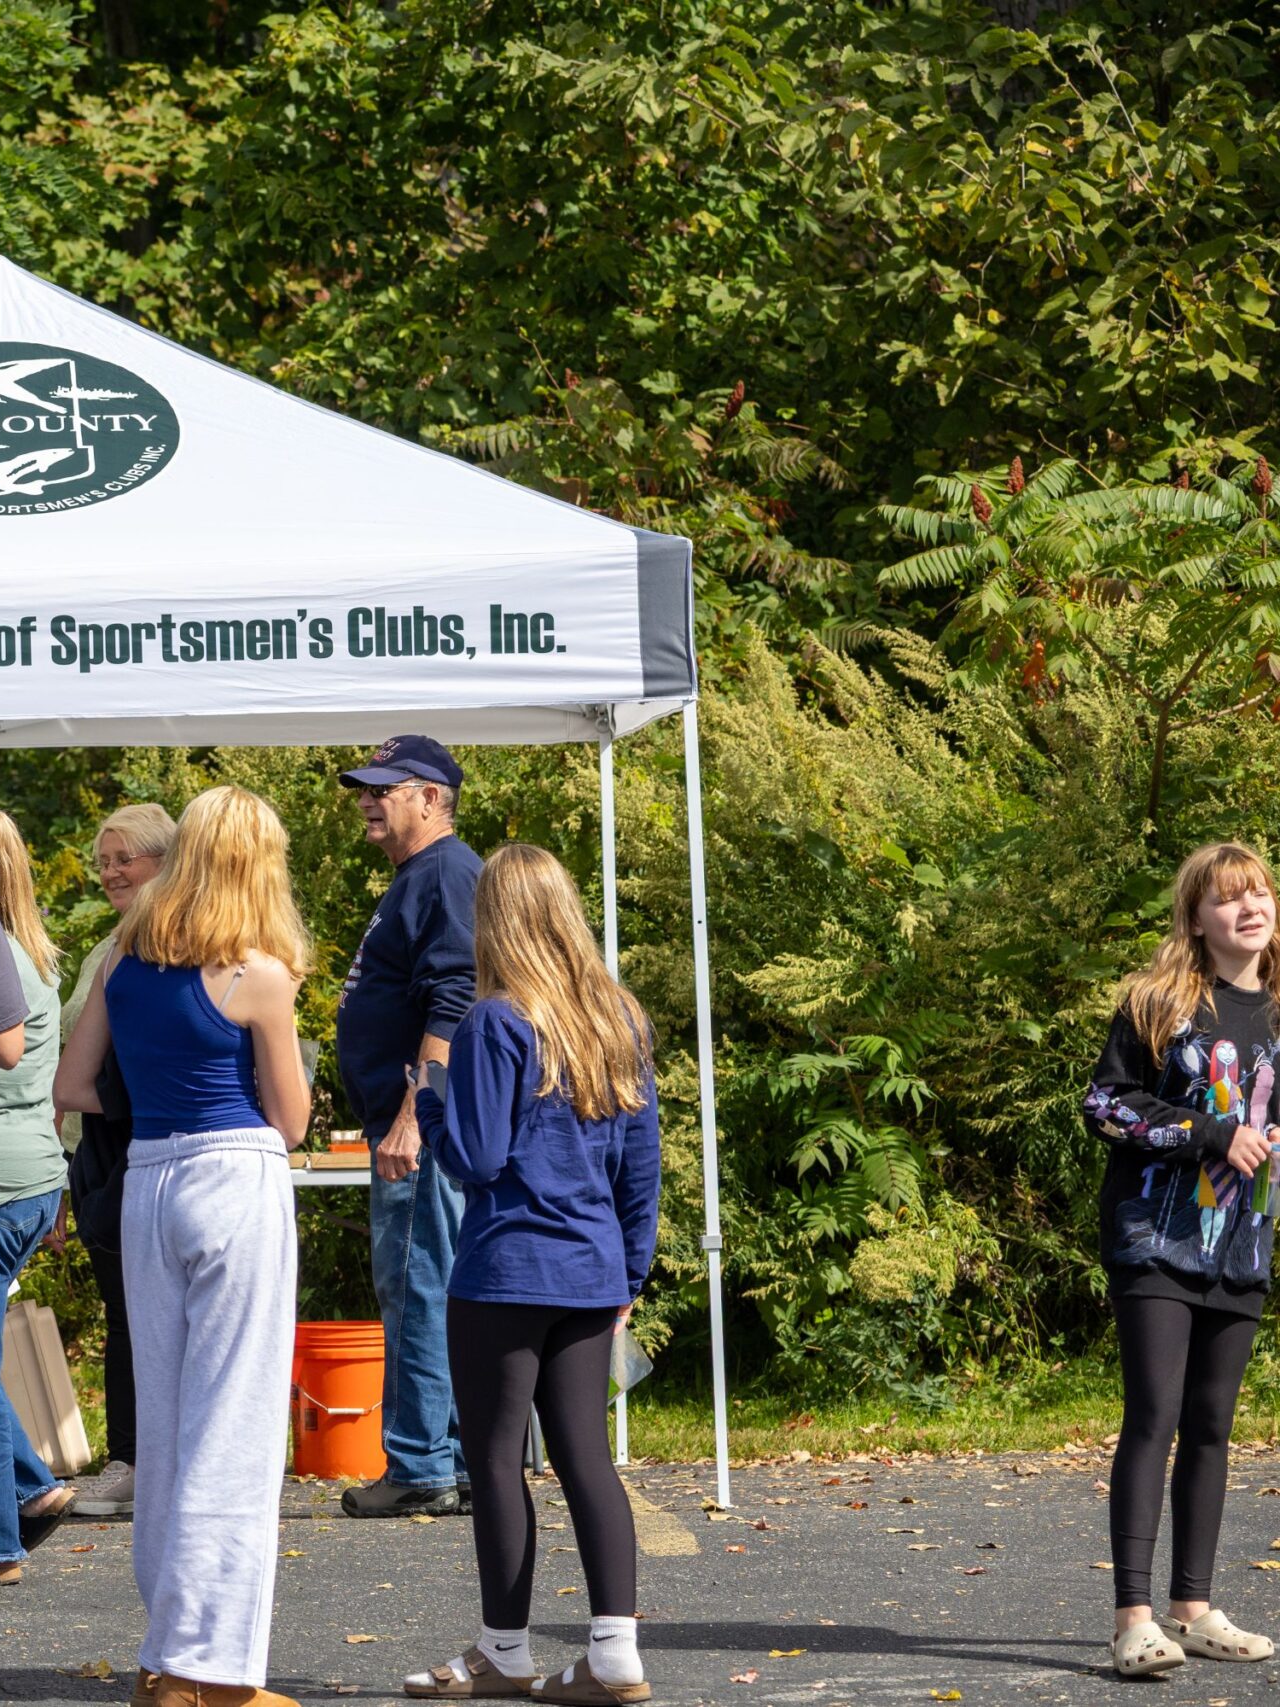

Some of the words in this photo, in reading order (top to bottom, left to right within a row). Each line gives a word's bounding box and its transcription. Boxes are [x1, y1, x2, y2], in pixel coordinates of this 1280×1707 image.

[104, 461, 152, 493] CLUBS
[144, 442, 168, 467] INC.
[49, 607, 334, 675] Sportsmen’s
[346, 604, 477, 661] Clubs,
[489, 603, 568, 656] Inc.
